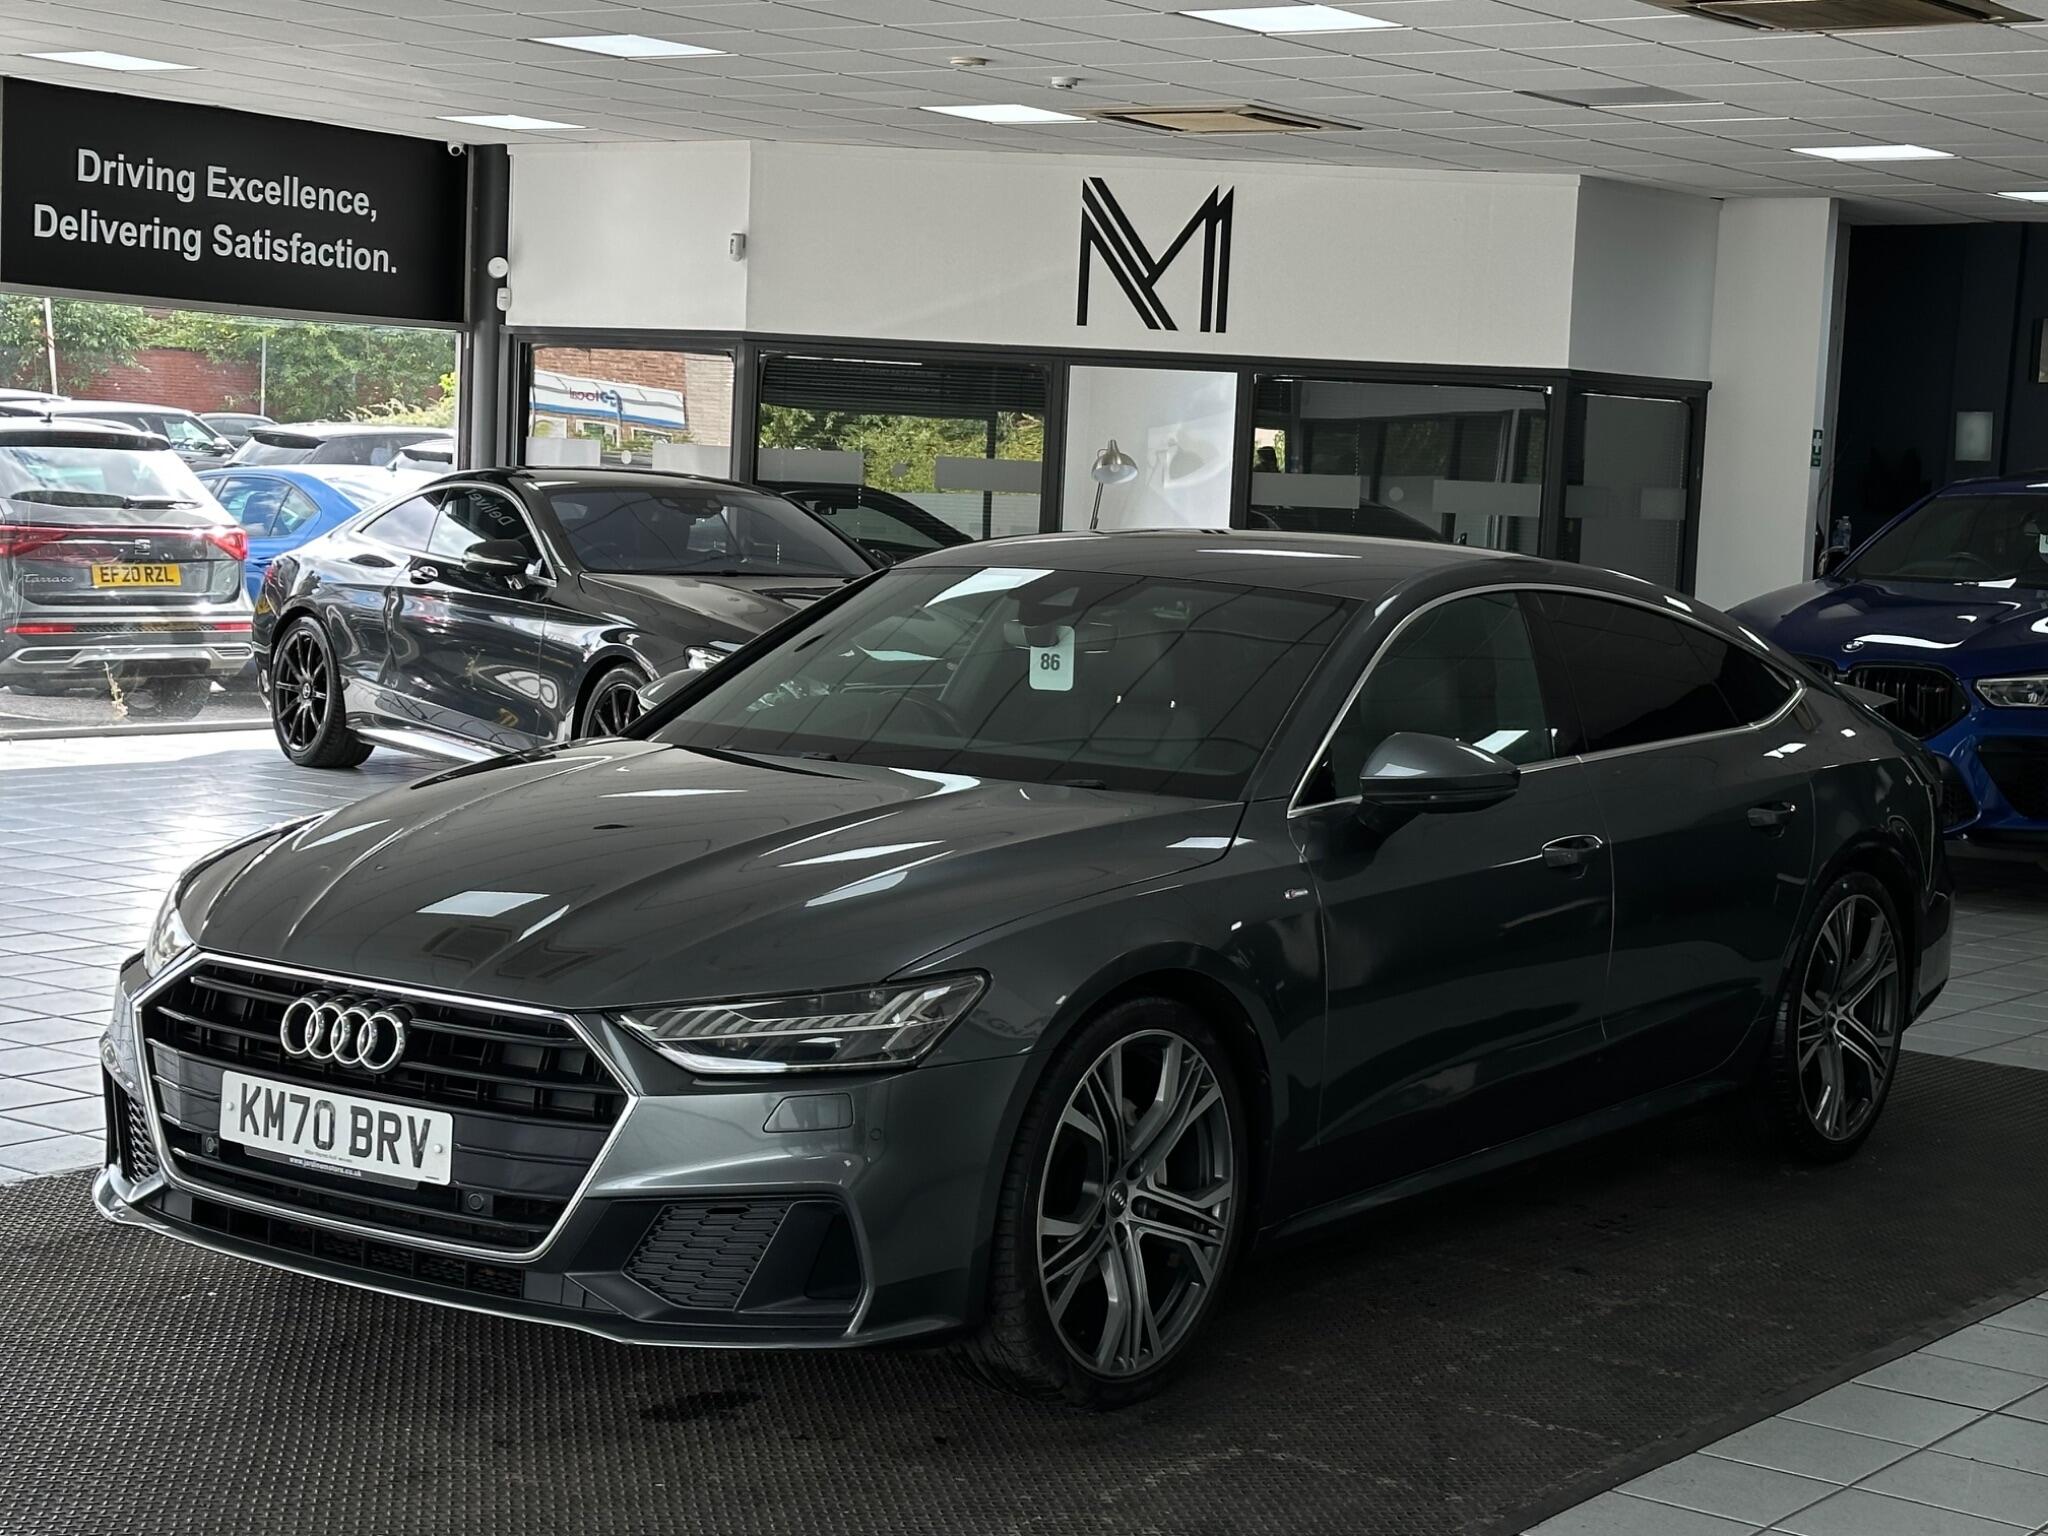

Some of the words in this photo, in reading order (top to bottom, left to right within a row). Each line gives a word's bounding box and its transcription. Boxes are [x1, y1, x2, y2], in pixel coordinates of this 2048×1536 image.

[77, 148, 196, 203] Driving
[206, 164, 378, 223] Excellence,
[33, 203, 202, 262] Delivering
[212, 223, 398, 274] Satisfaction.
[22, 573, 75, 584] Tarraco
[100, 565, 141, 583] EF20
[145, 565, 175, 583] RZL
[1040, 652, 1061, 671] 86
[239, 1082, 337, 1151] KM70
[348, 1104, 432, 1169] BRV
